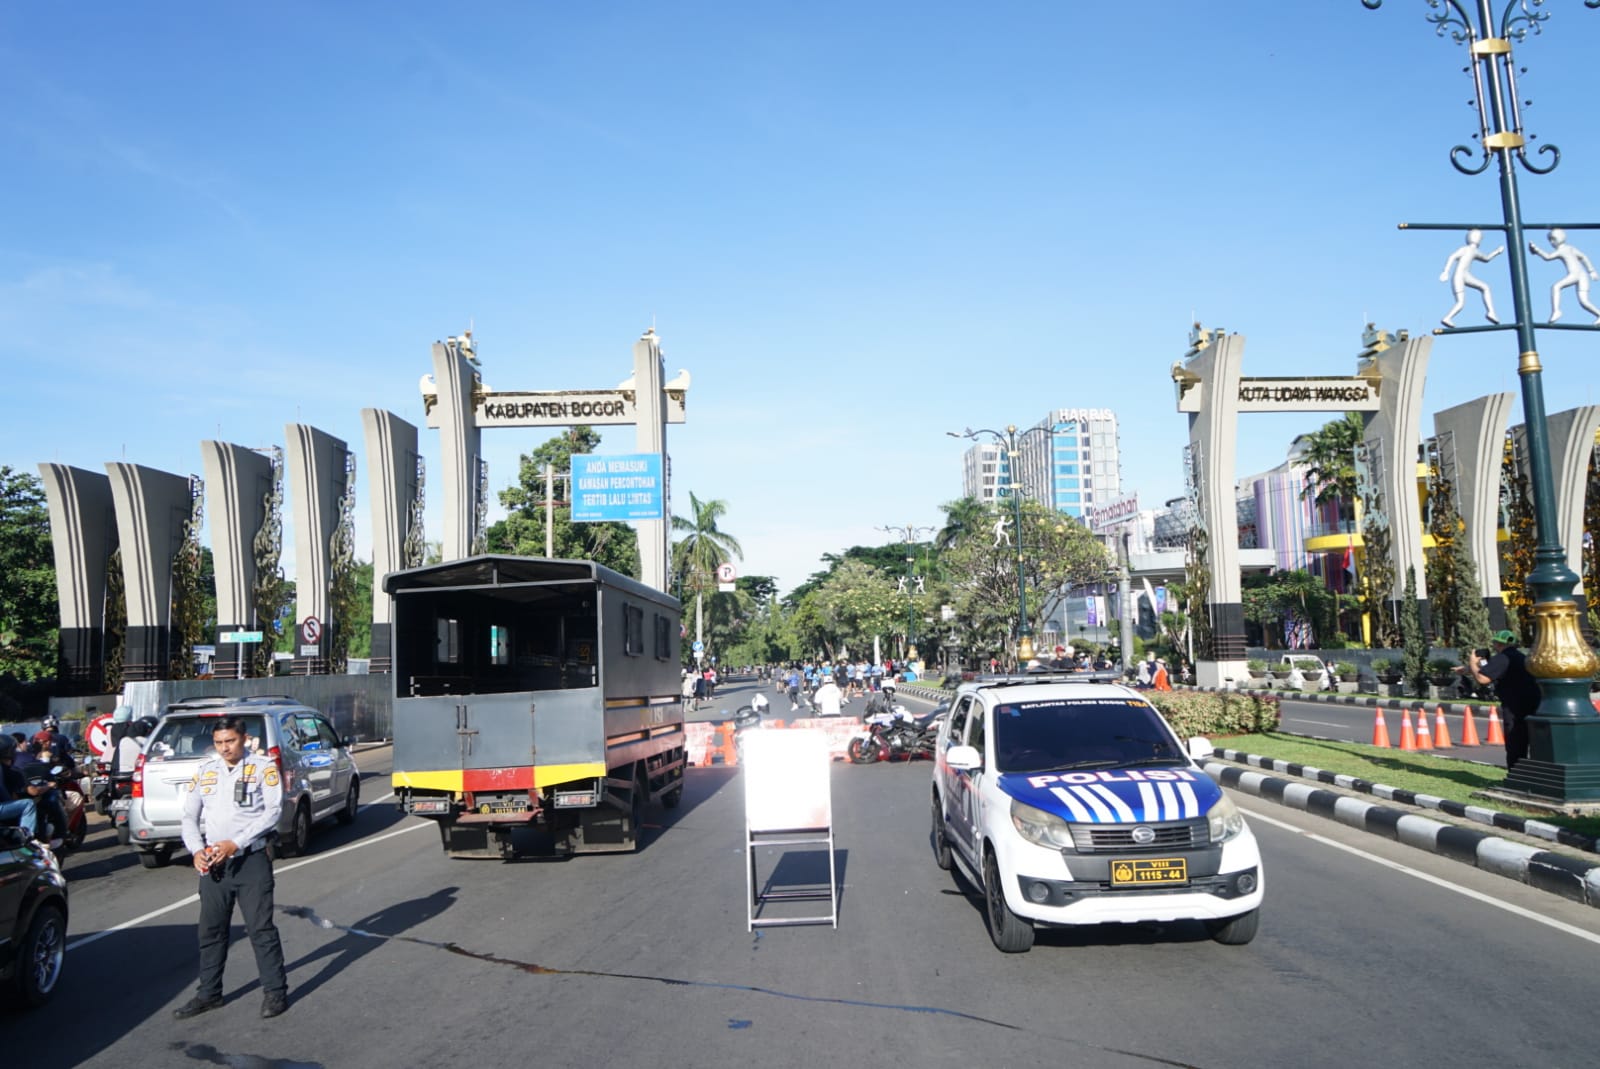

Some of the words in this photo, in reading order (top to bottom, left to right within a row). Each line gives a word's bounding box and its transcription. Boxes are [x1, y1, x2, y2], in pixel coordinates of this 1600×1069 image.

[1239, 387, 1269, 401] KUTA
[1275, 387, 1312, 401] UDAYA
[1316, 387, 1368, 401] WANGSA
[484, 402, 568, 419] KABUPATEN
[571, 401, 625, 417] BOGOR
[1059, 408, 1113, 422] HARRIS
[586, 461, 606, 473] ANDA
[608, 460, 648, 472] MEMASUKI
[579, 478, 608, 490] KAWASAN
[583, 493, 606, 506] TERTIB
[609, 493, 626, 506] LALU
[628, 492, 652, 505] LINTAS
[1028, 770, 1197, 788] POLISI
